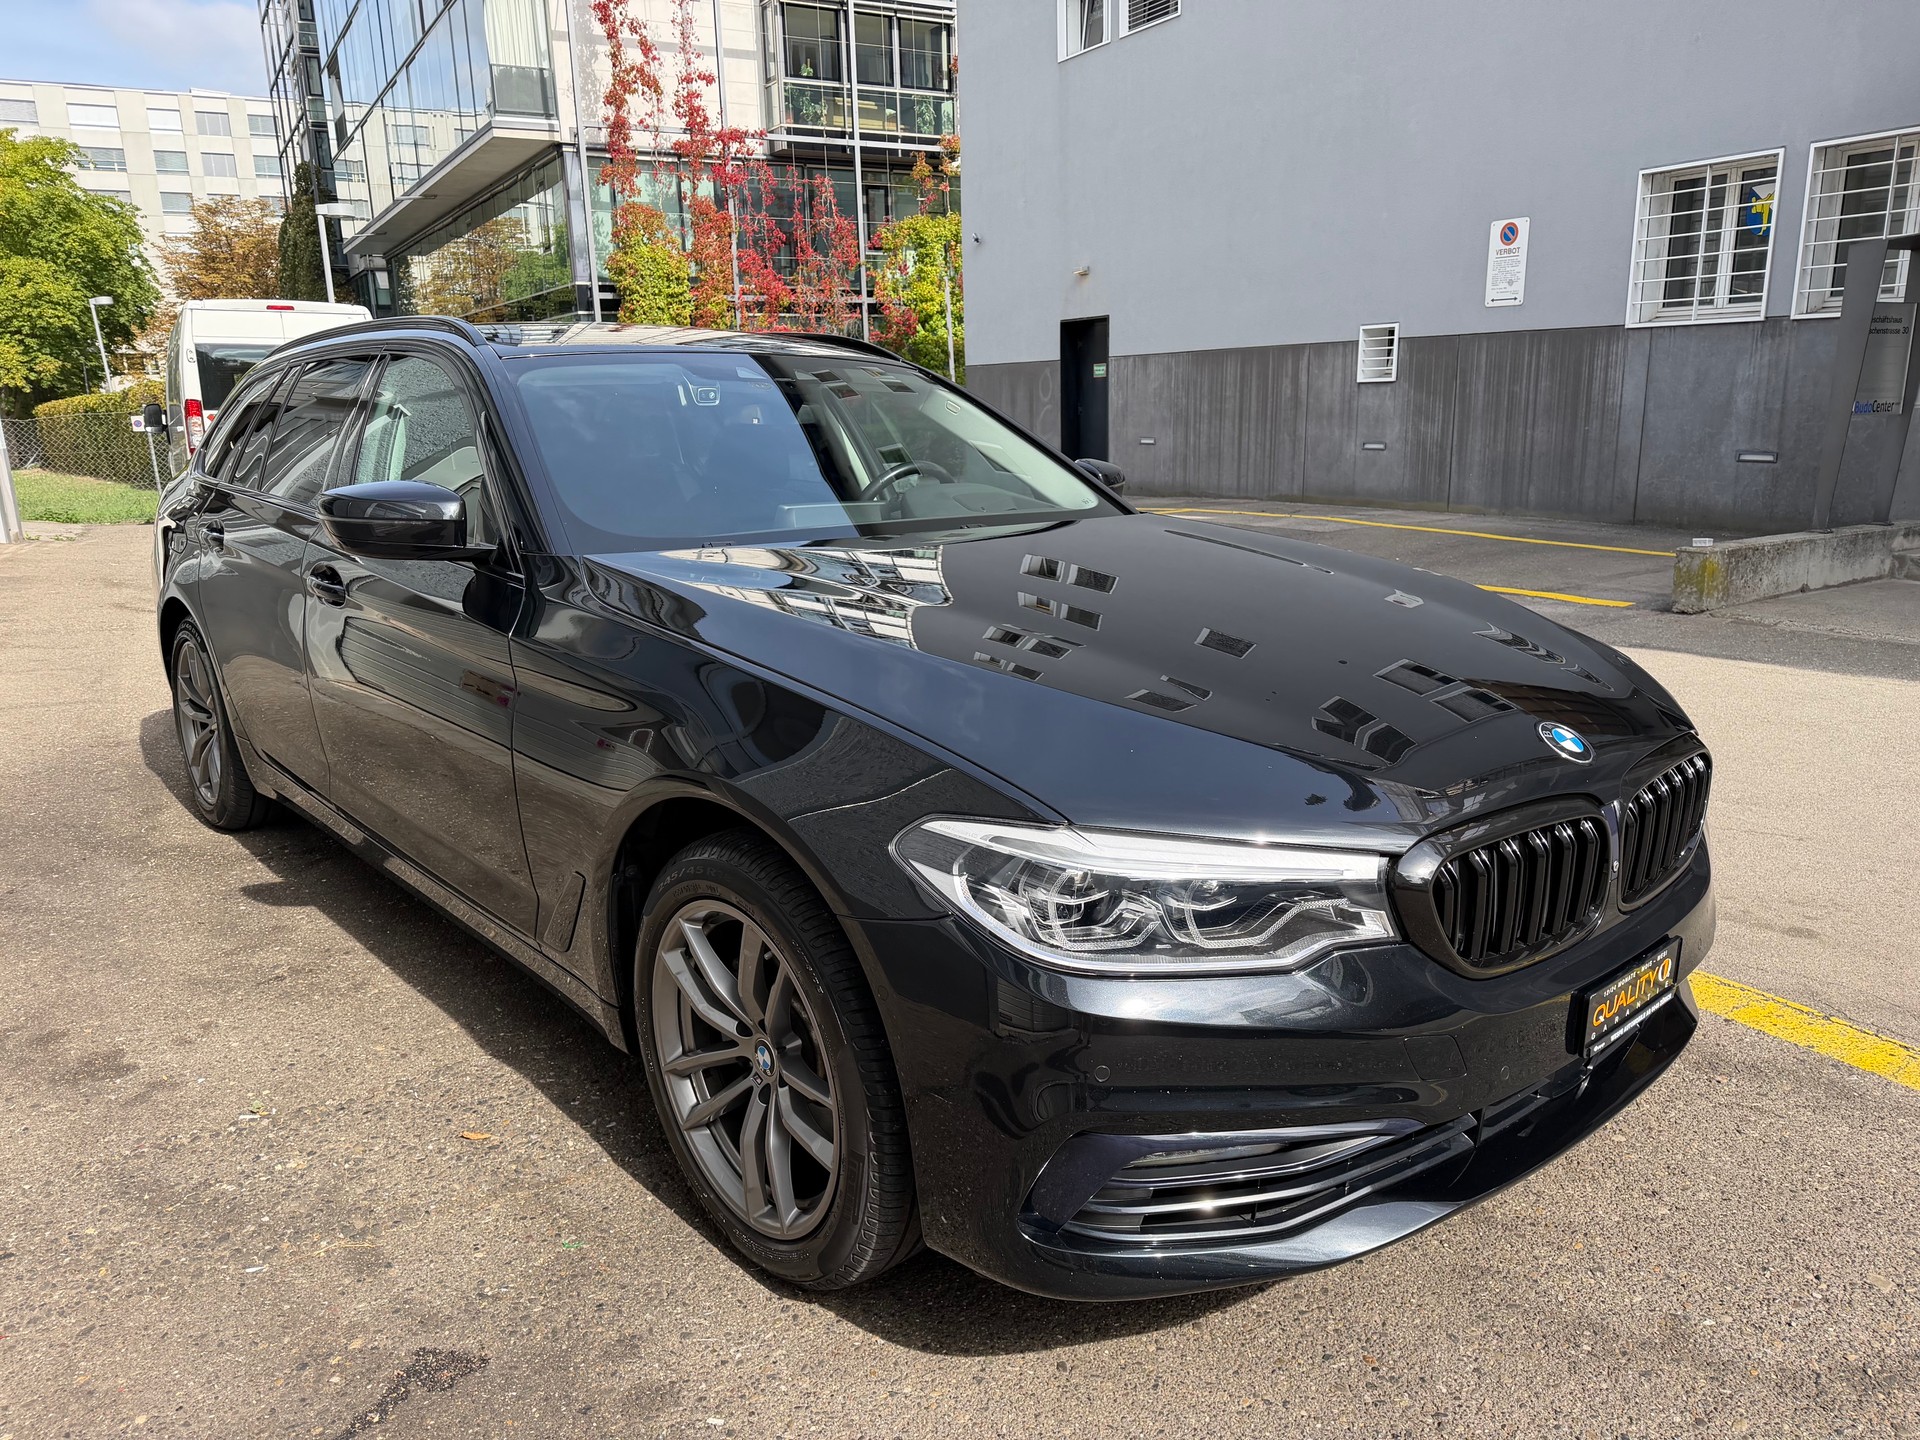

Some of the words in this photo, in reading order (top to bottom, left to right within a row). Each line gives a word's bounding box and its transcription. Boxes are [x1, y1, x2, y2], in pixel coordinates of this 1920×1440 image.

[1495, 247, 1520, 256] VERBOT
[1902, 326, 1910, 335] 30
[1854, 400, 1895, 414] BudoCenter
